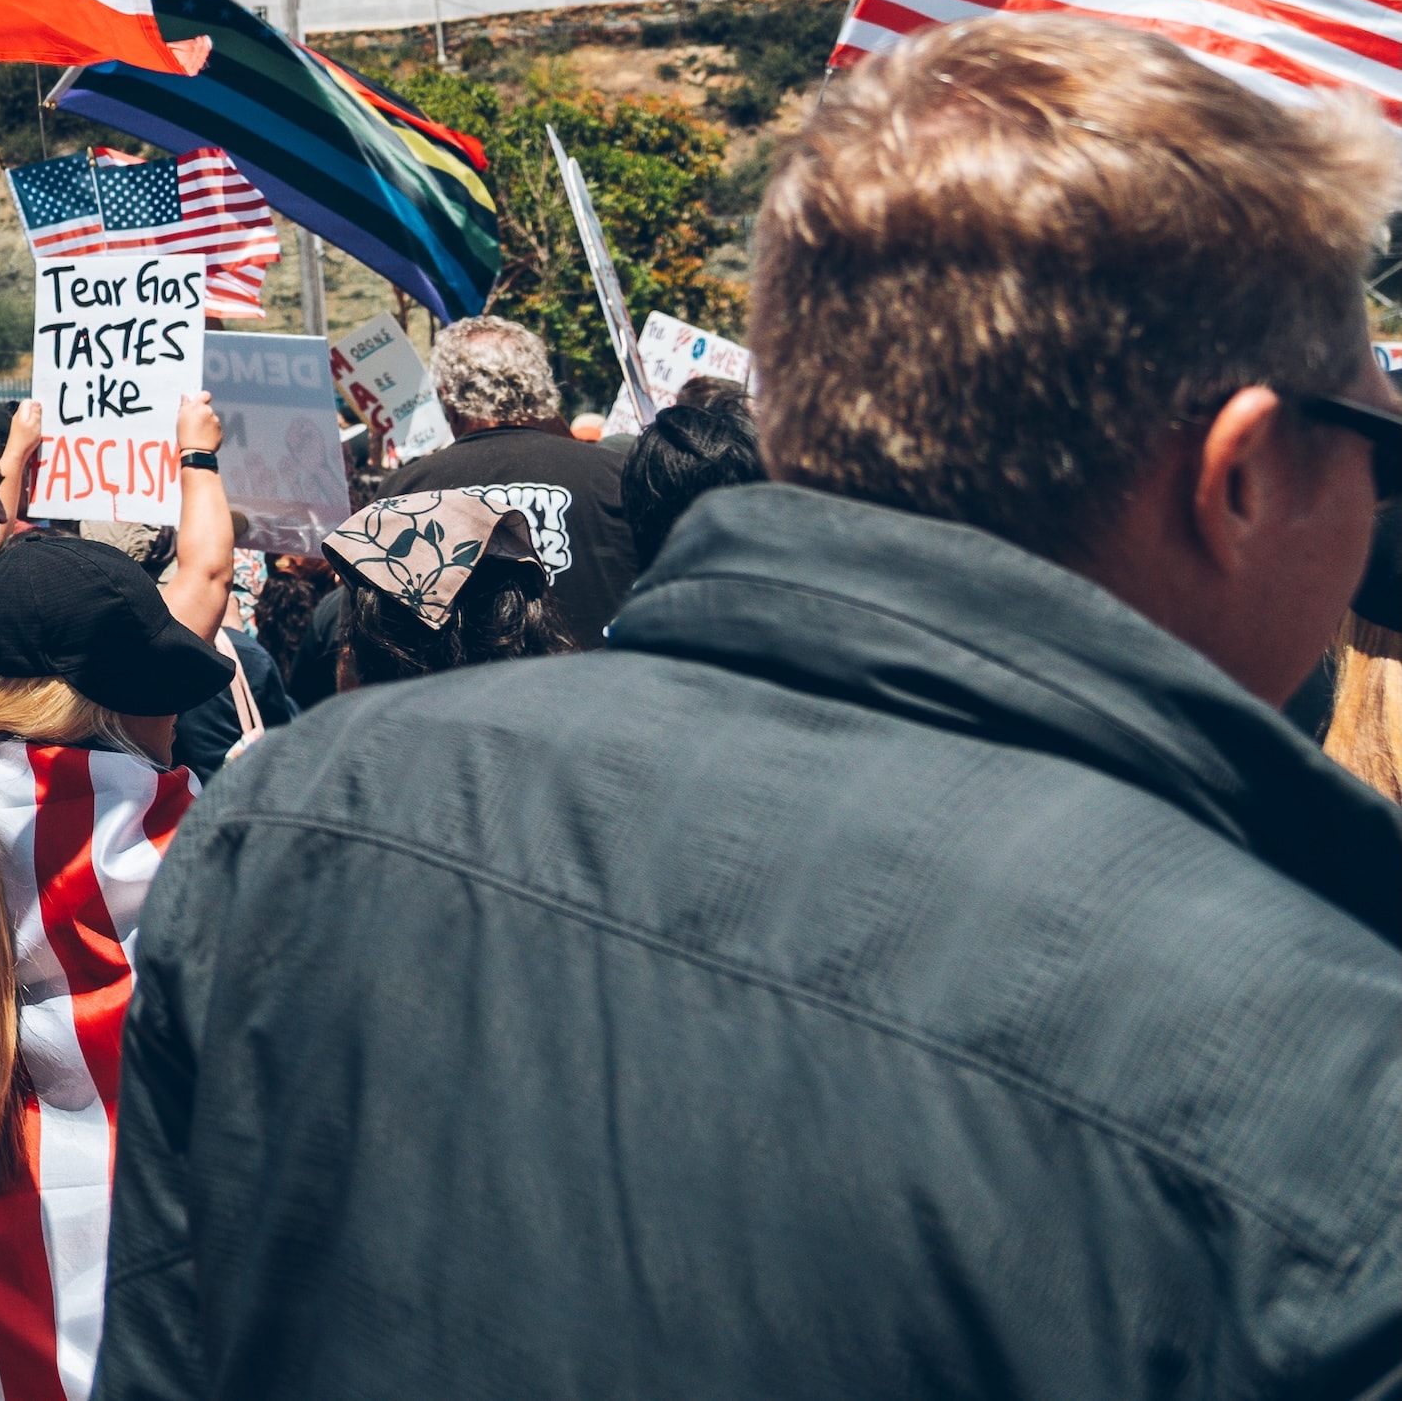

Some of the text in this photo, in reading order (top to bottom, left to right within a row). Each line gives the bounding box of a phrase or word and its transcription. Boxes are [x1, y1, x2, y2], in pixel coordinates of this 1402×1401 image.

[42, 260, 202, 313] Tear Gas
[39, 318, 189, 369] TASTES
[59, 374, 152, 425] Like
[28, 435, 181, 503] FASCISM
